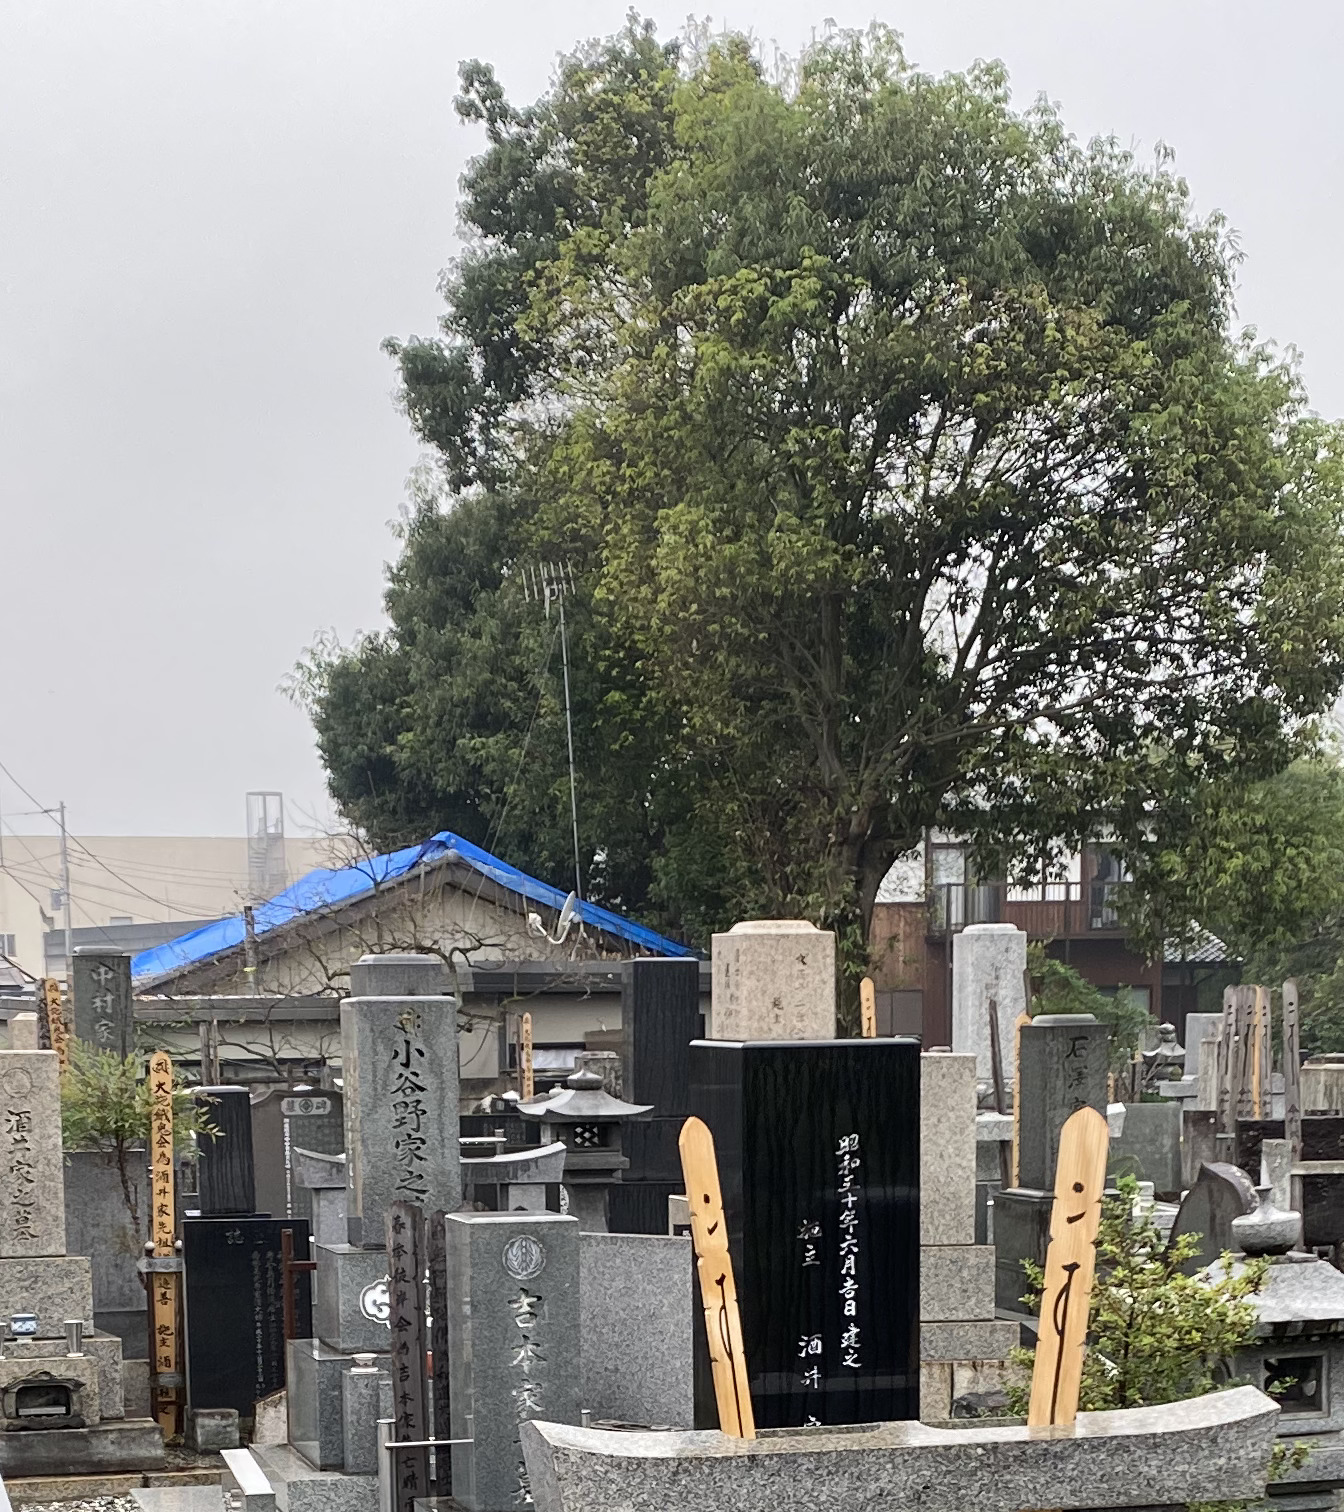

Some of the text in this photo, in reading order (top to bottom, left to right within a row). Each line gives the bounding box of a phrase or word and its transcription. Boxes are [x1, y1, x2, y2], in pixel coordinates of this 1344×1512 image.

[91, 965, 116, 1042] 中村家
[390, 1039, 430, 1203] 小谷野家之
